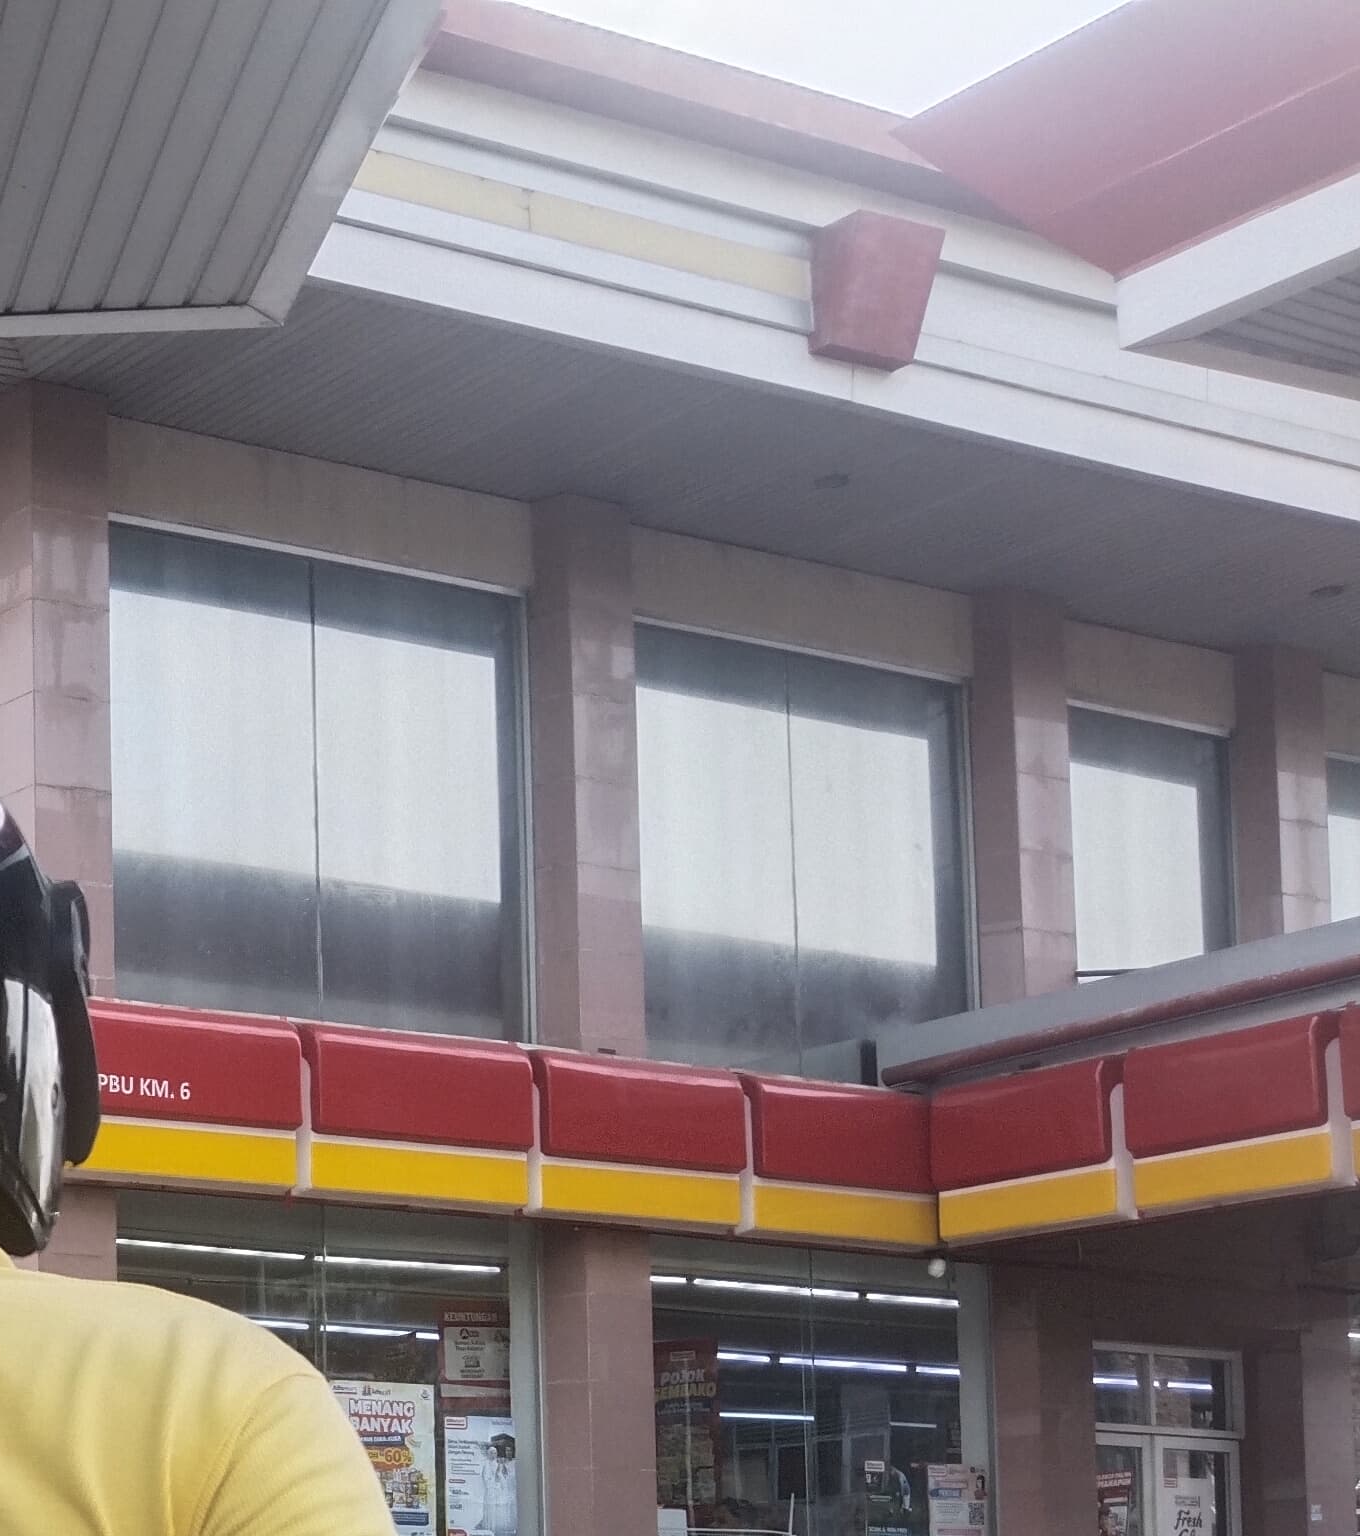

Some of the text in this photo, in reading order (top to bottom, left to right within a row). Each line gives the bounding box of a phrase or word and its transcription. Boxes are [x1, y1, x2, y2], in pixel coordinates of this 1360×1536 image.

[97, 1073, 191, 1100] PBU KM. 6
[349, 1399, 415, 1416] MENANG
[350, 1415, 413, 1434] BANYAK
[1174, 1510, 1202, 1531] Fresh
